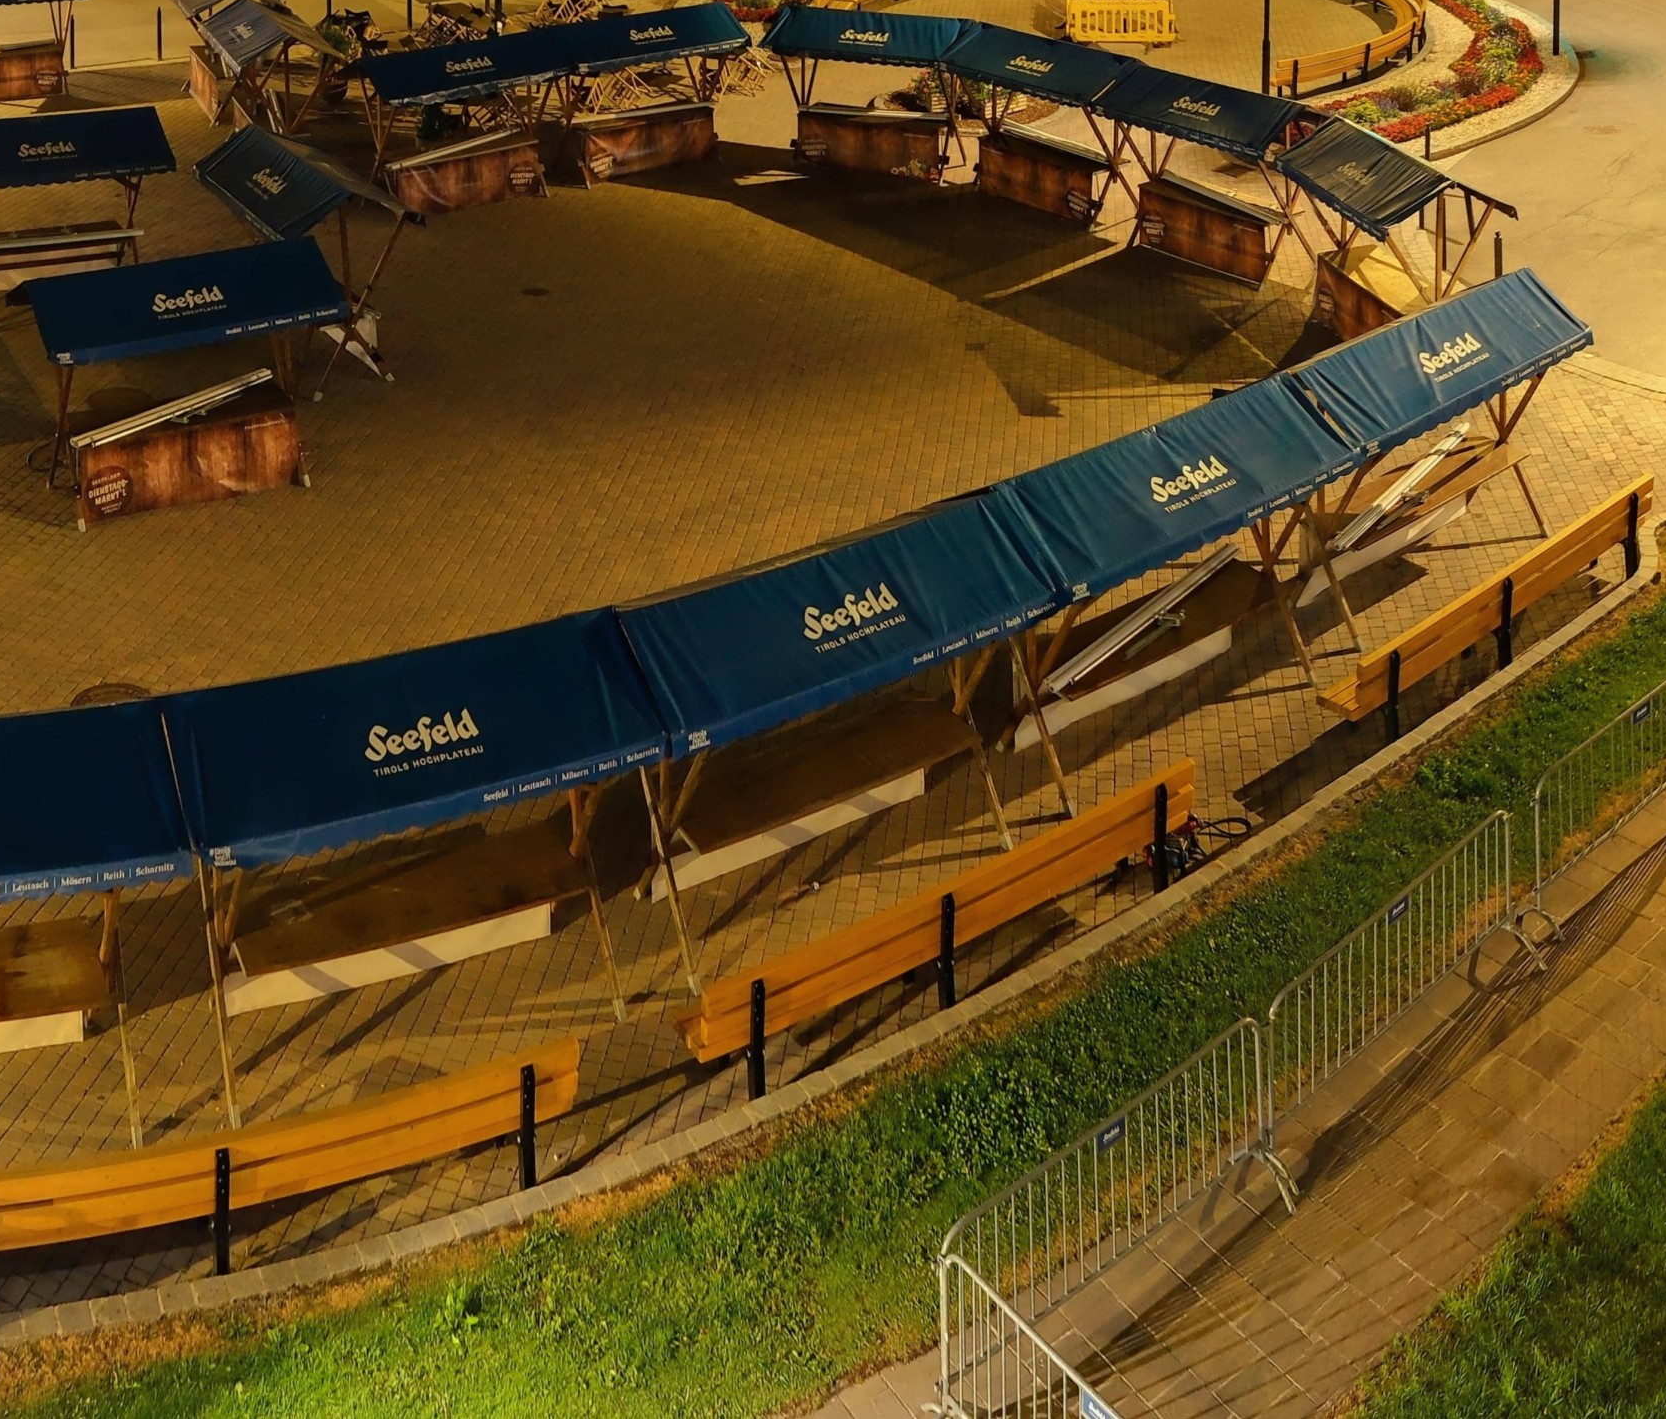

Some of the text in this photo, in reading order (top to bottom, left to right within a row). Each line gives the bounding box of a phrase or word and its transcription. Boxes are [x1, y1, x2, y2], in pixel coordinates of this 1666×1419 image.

[629, 25, 674, 41] Seefeld
[840, 28, 890, 44] Seefeld
[445, 56, 493, 73] Seefeld
[1010, 55, 1055, 74] Seefeld
[1173, 96, 1222, 118] Seefeld
[18, 140, 76, 159] Seefeld
[152, 285, 225, 313] Seefeld
[1419, 331, 1482, 375] Seefeld
[1150, 454, 1229, 504] Seefeld
[1164, 477, 1237, 515] TIROLS HOCHPLATEAU
[802, 581, 899, 641] Seefeld
[815, 613, 907, 655] TIROLS HOCHPLATEAU
[912, 649, 935, 666] Seefeld
[941, 636, 968, 656] Leutasch
[1005, 614, 1022, 628] Reith
[1027, 600, 1057, 620] Scharnitz
[364, 707, 480, 763] Seefeld
[373, 744, 485, 779] TIROLS HOCHPLATEAU
[483, 745, 661, 803] Seefeld Leutasch Mösern Reith Scharnitz
[12, 878, 50, 893] Leutasch
[60, 872, 93, 888] Mösern
[103, 868, 126, 882] Reith
[135, 861, 176, 877] Scharnitz
